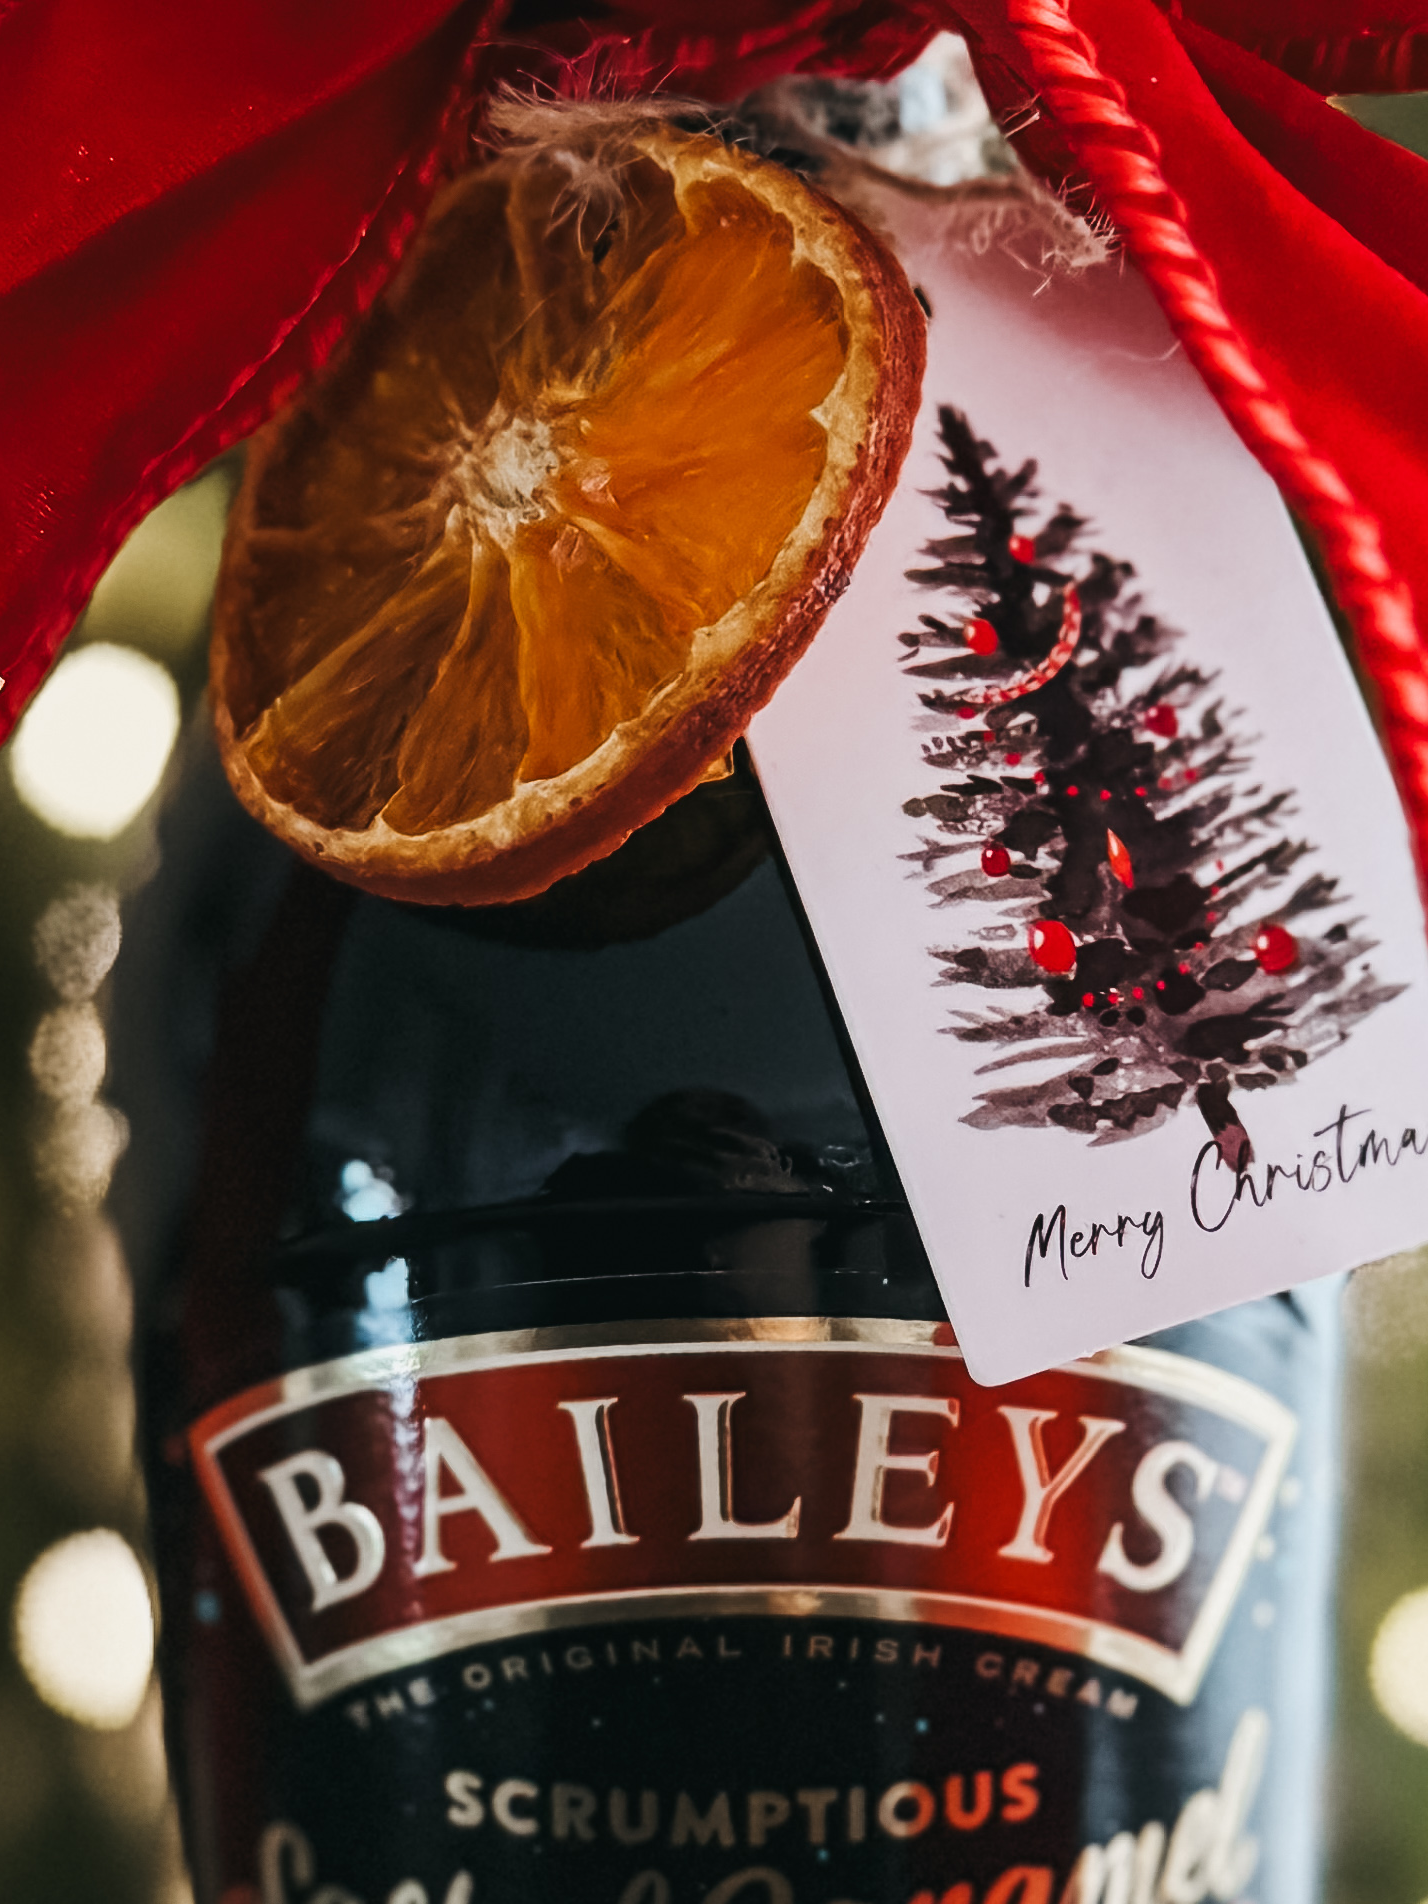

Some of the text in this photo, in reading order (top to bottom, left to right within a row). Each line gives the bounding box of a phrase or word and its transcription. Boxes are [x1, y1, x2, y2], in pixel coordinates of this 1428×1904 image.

[1023, 1203, 1165, 1288] Merry
[257, 1389, 1225, 1614] BAILEYS
[346, 1634, 1140, 1728] THE ORIGINAL IRISH CREAM
[445, 1762, 1041, 1847] SCRUMPTIOUS
